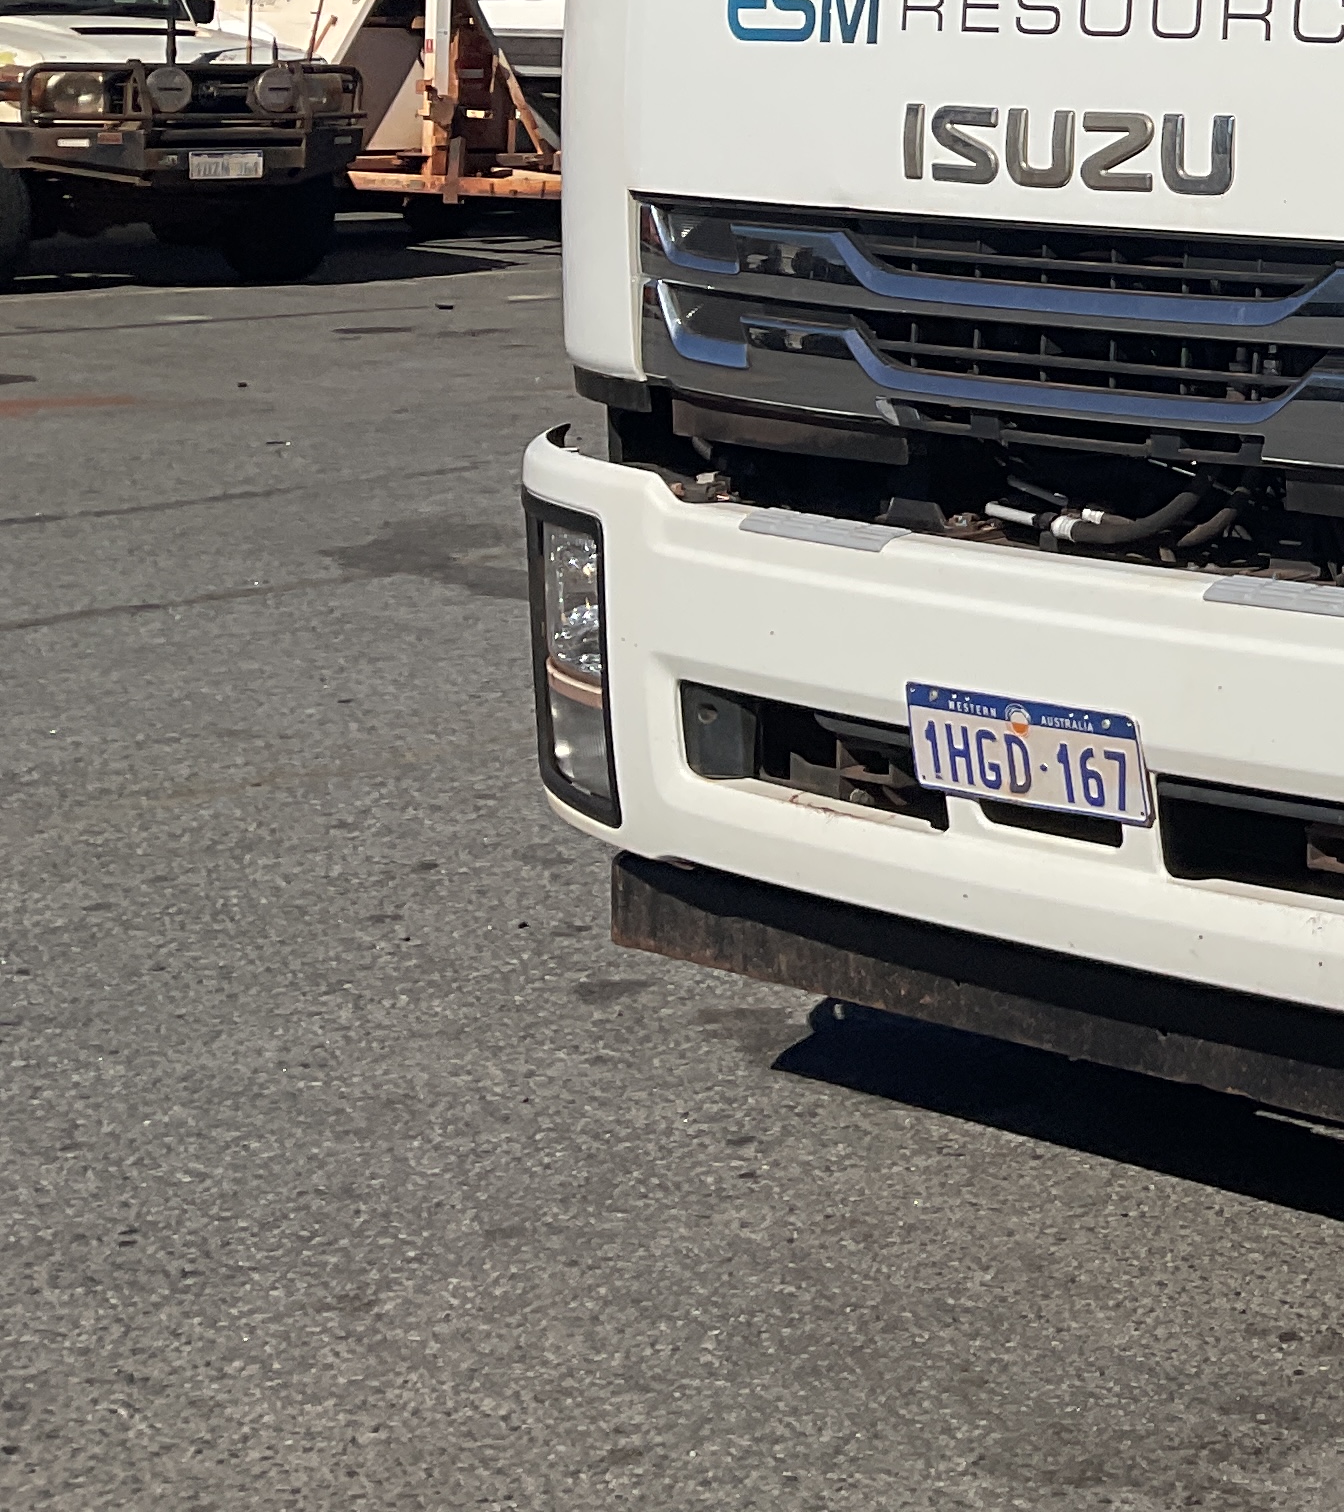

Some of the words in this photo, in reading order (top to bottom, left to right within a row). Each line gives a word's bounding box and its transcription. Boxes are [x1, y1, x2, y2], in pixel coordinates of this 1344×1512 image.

[902, 103, 1237, 196] ISUZU
[948, 699, 997, 719] WESTERN
[1041, 714, 1094, 733] AUSTRALIA
